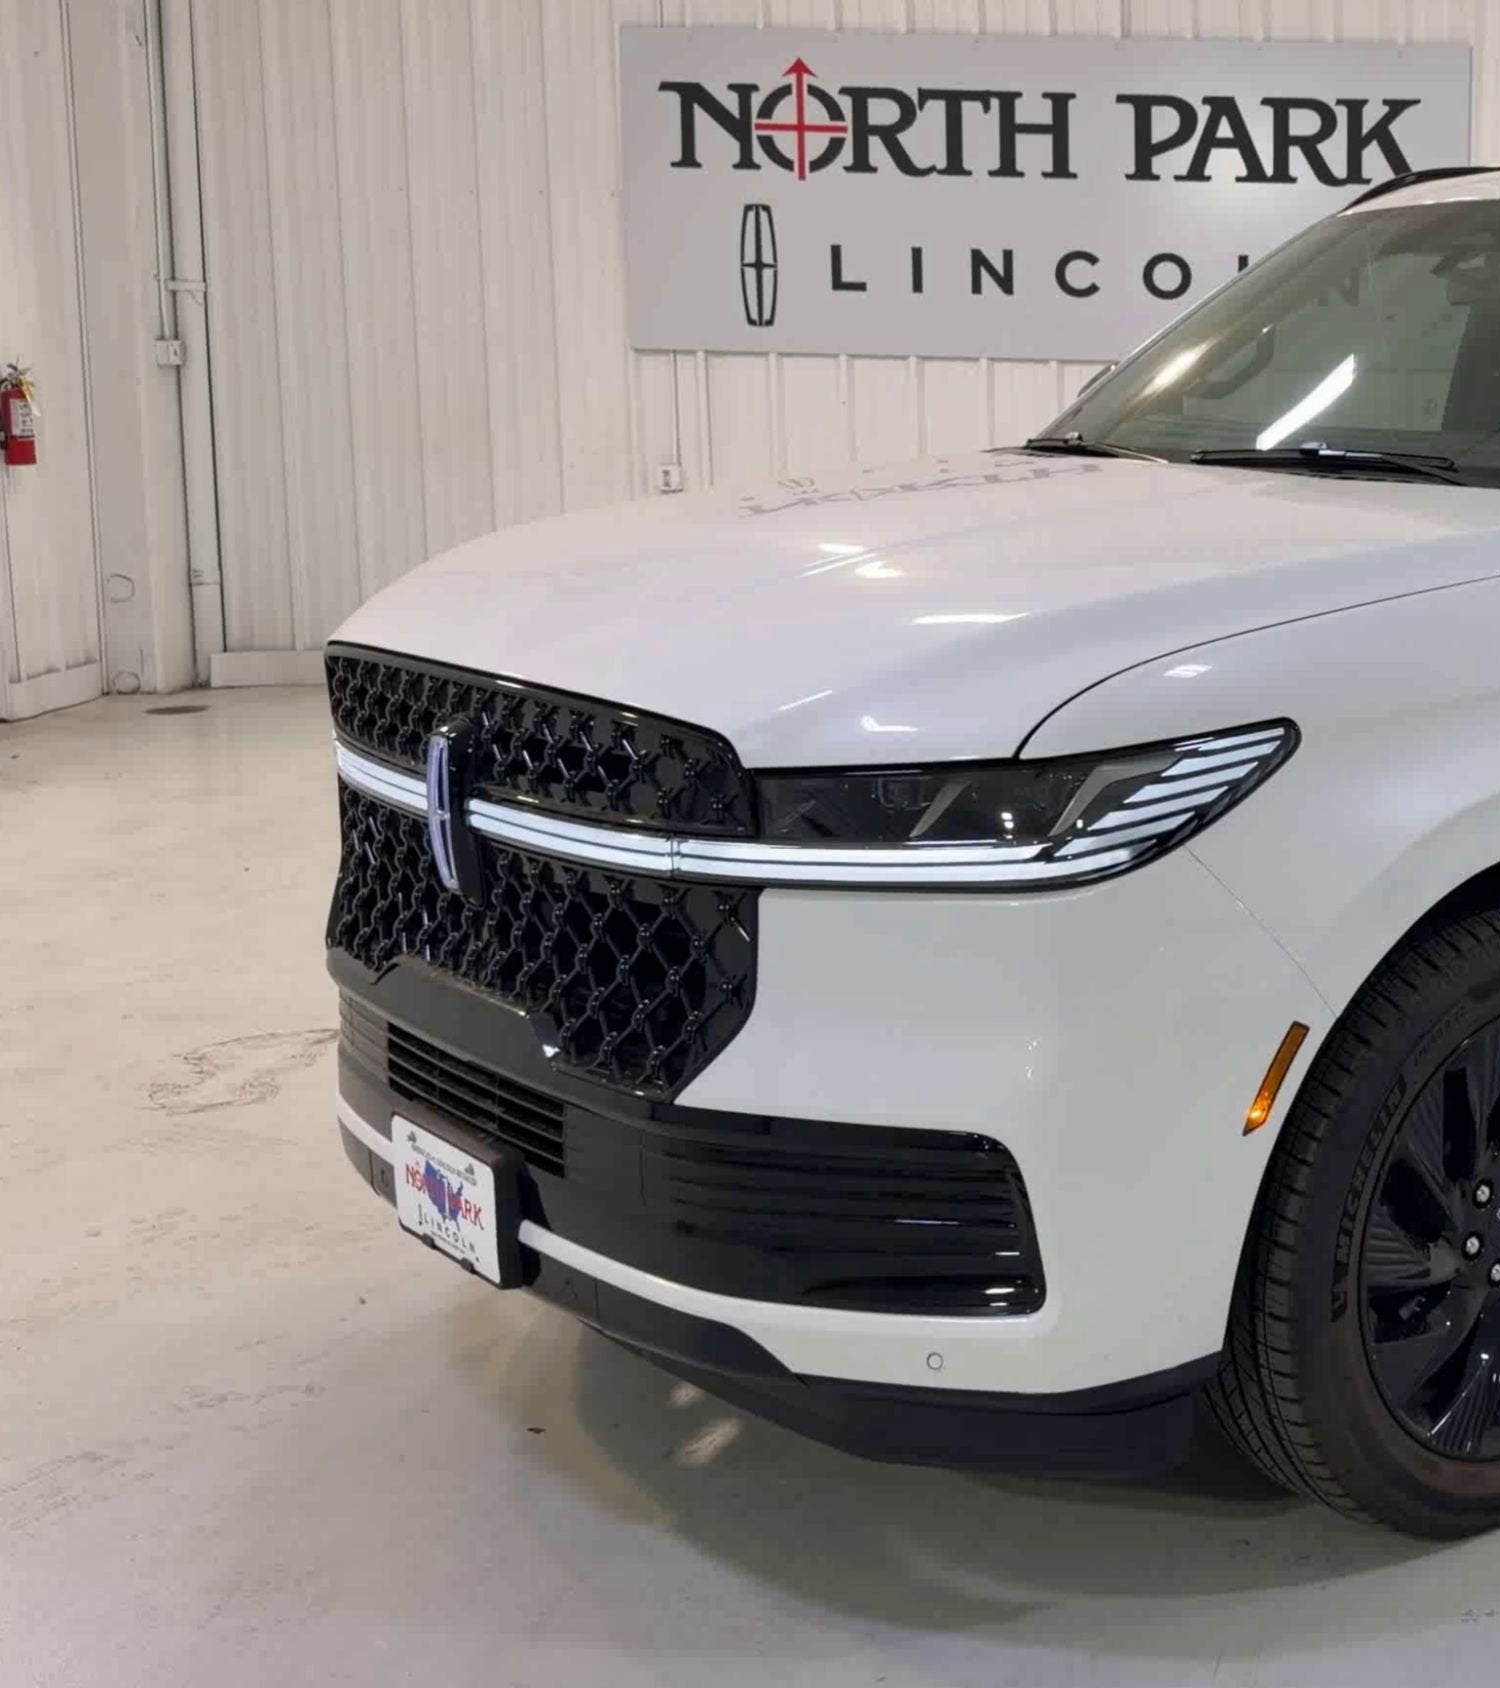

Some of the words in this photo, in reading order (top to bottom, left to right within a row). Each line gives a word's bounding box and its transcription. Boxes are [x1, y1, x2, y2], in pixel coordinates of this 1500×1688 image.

[658, 80, 1078, 181] NORTH
[1116, 93, 1422, 187] PARK
[424, 1211, 476, 1255] LINCOLN
